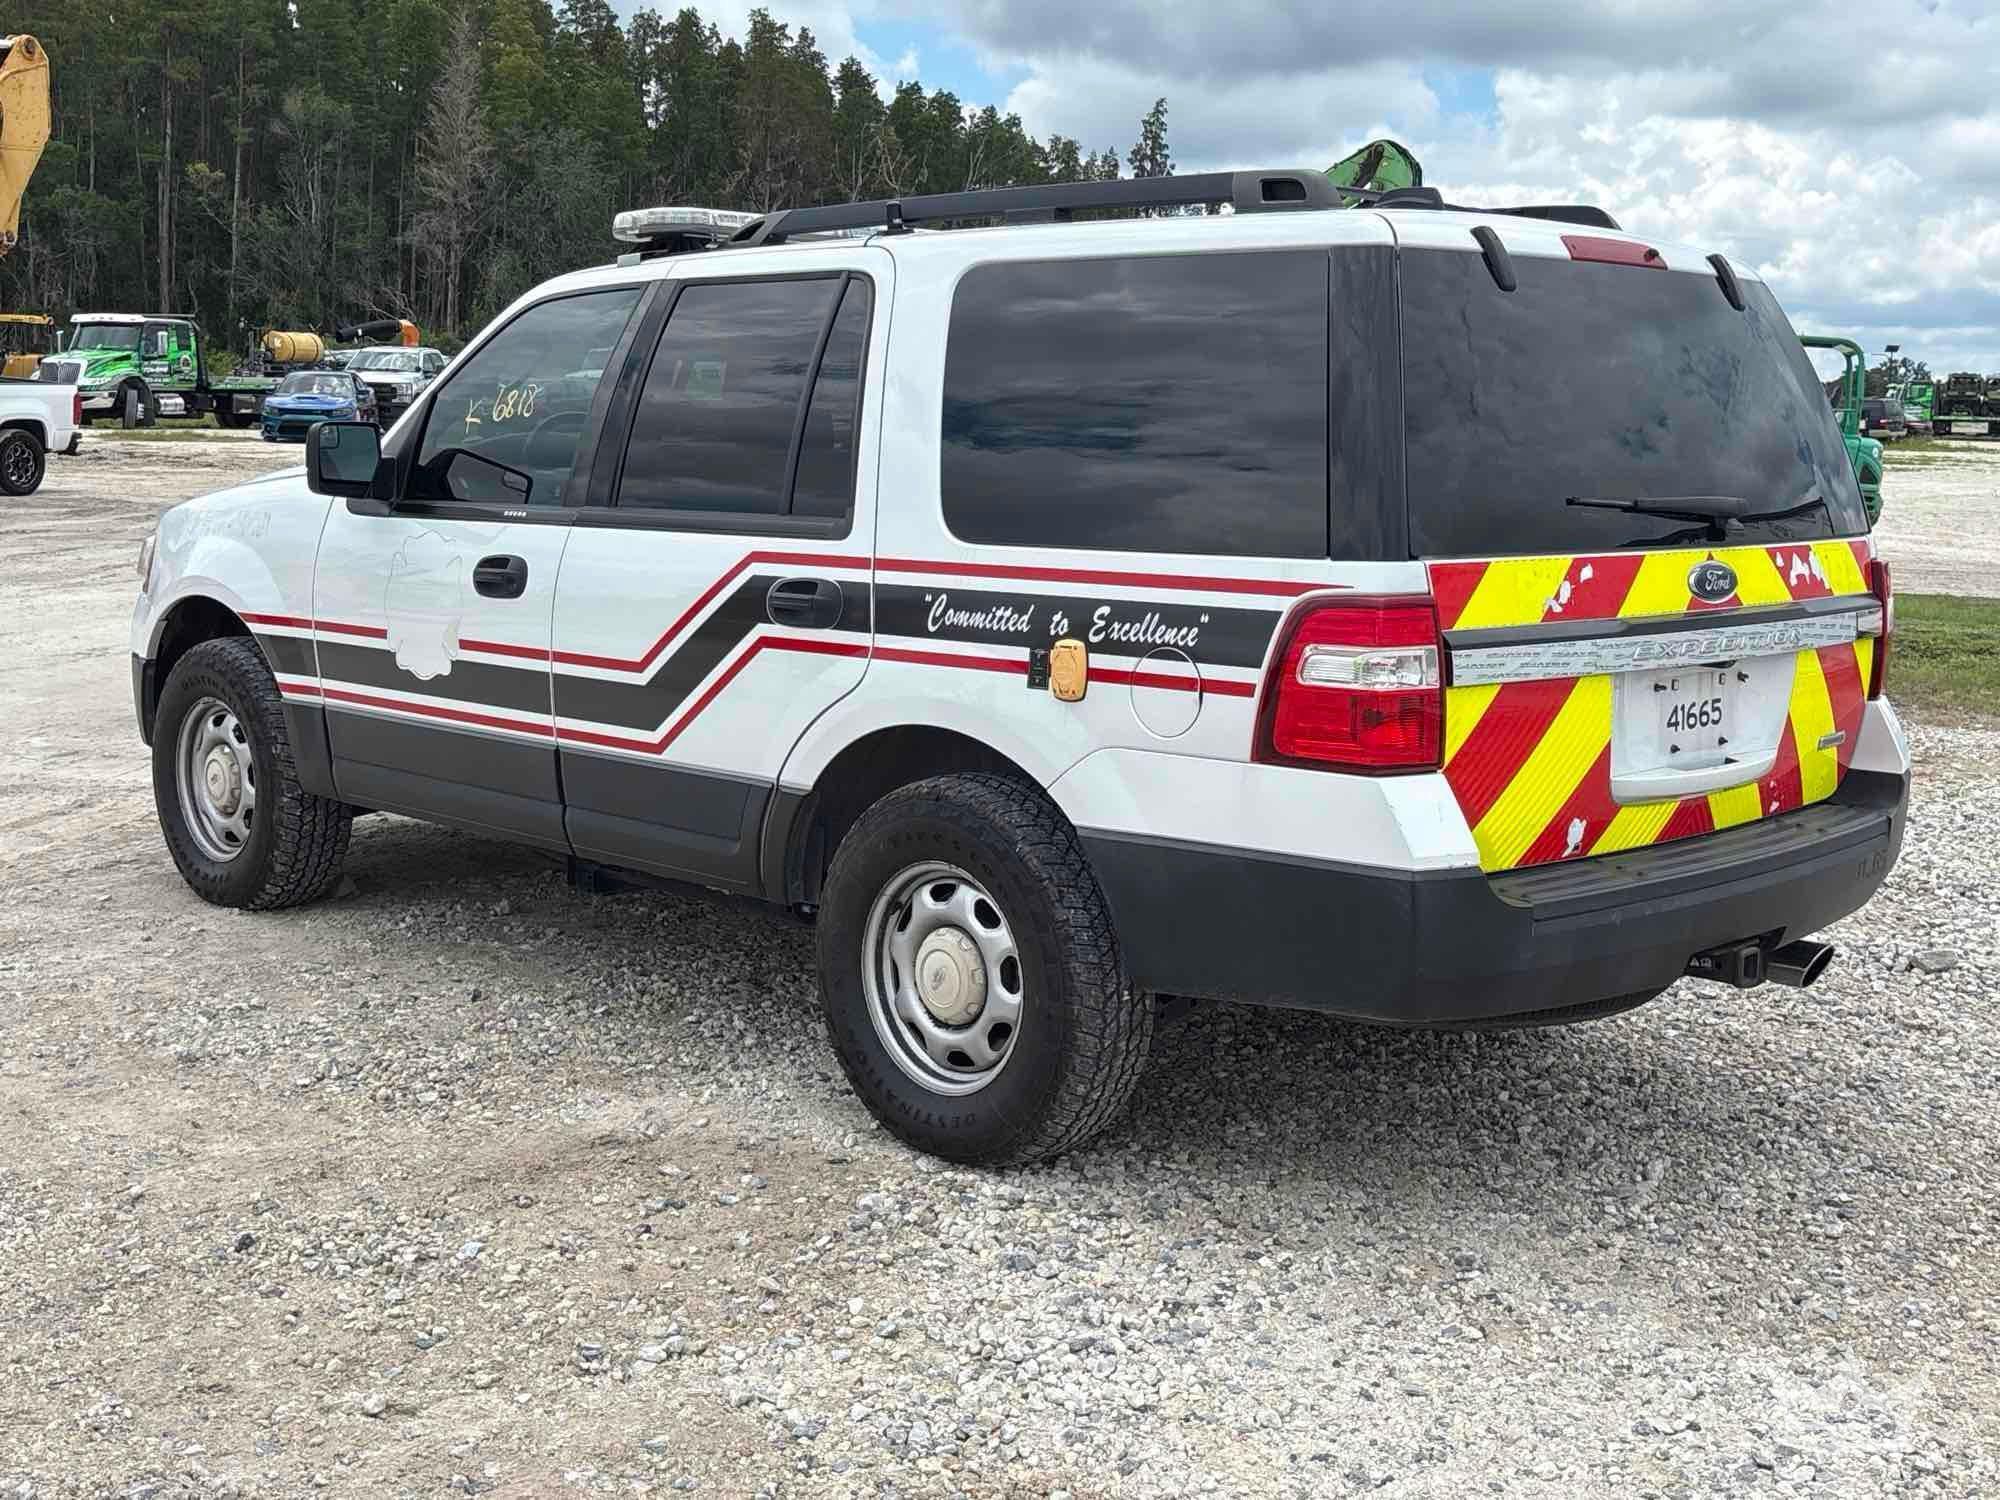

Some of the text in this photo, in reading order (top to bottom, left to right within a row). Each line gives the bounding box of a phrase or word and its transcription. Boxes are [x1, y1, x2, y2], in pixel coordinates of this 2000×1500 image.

[493, 384, 541, 422] 6818
[1705, 570, 1732, 591] Ford
[924, 593, 1209, 647] "Committed to Excellence"
[1631, 628, 1803, 662] EXPEDITION
[1666, 698, 1723, 732] 41665
